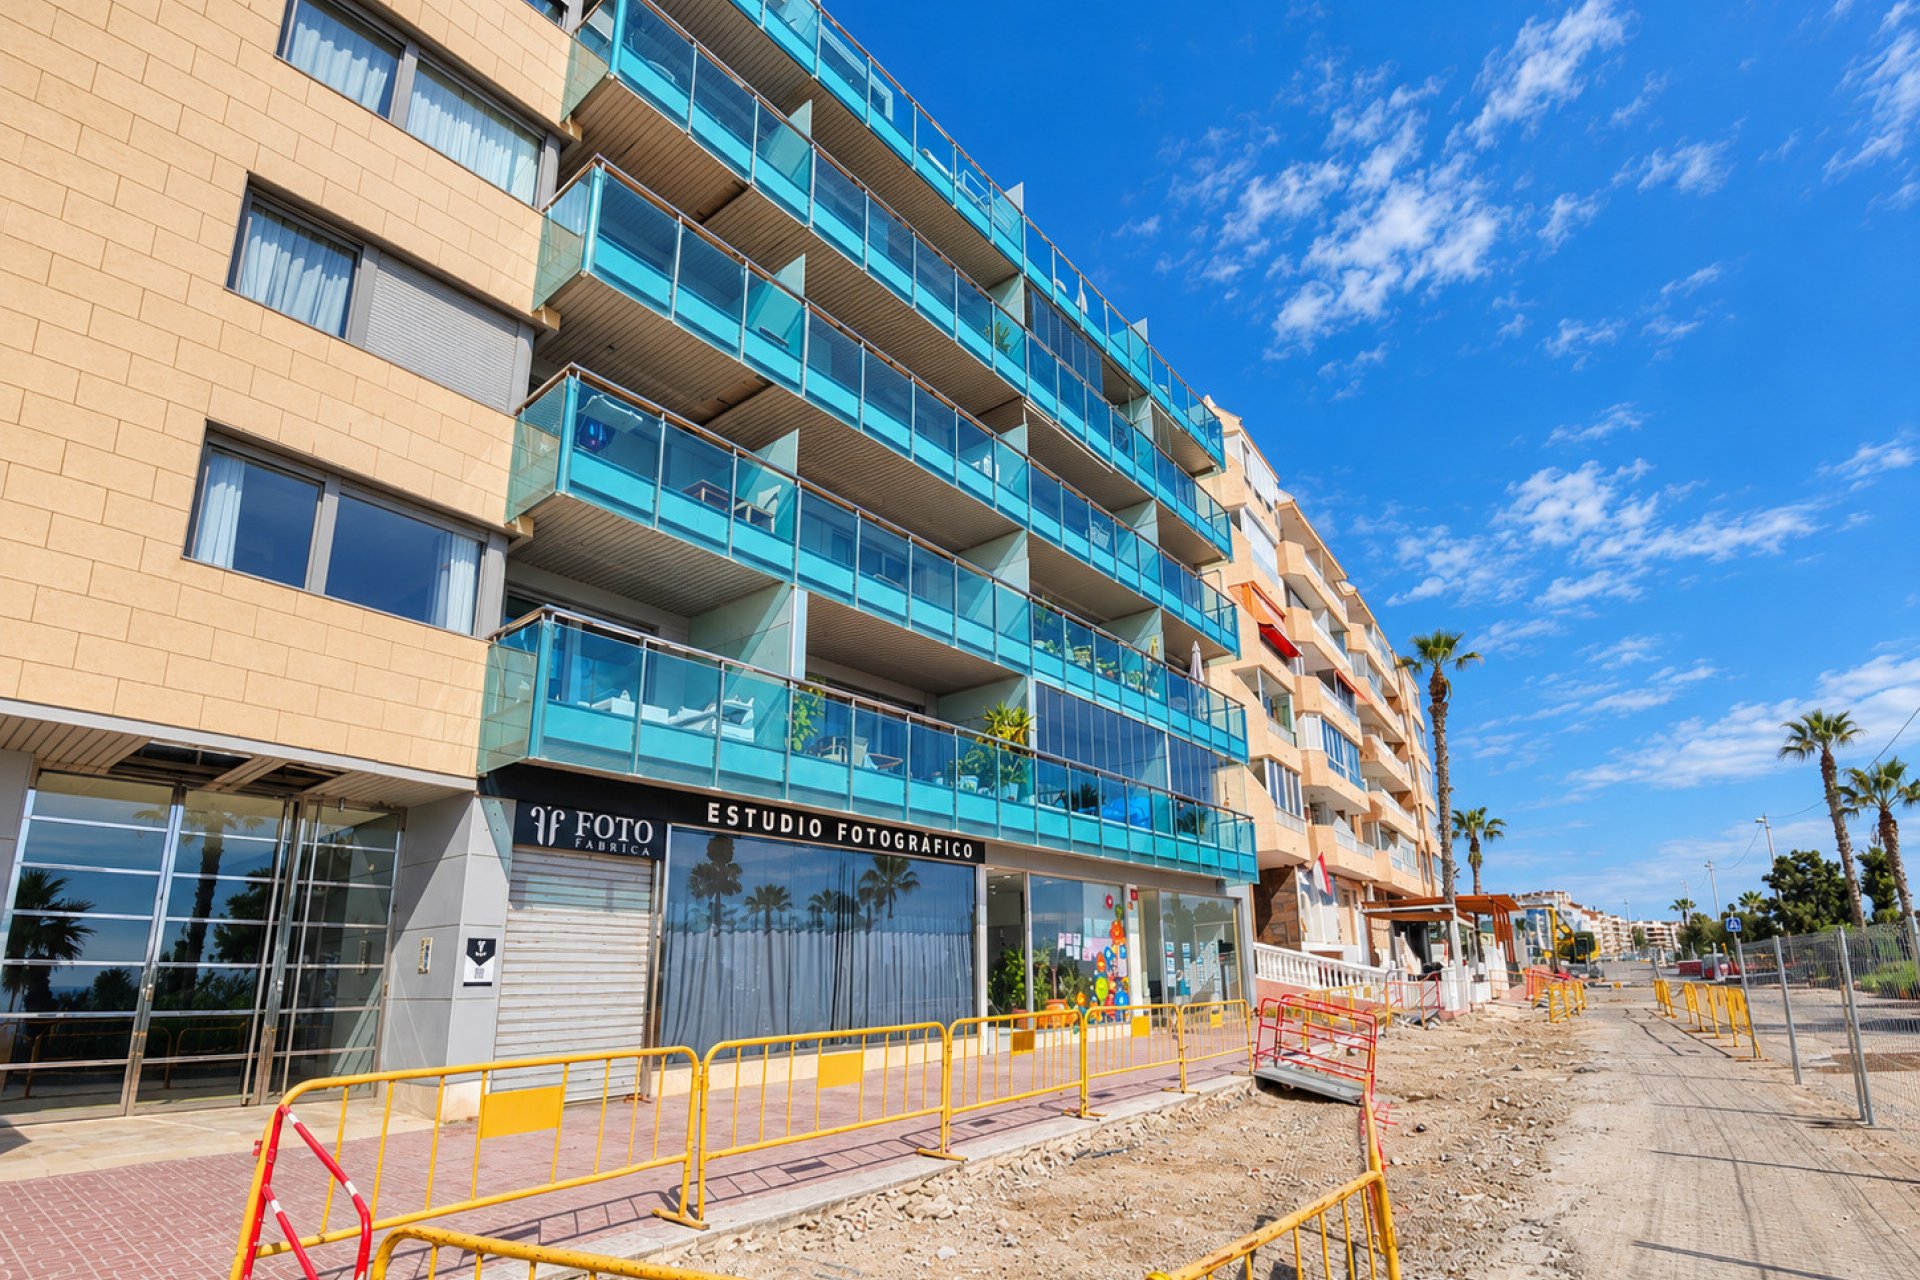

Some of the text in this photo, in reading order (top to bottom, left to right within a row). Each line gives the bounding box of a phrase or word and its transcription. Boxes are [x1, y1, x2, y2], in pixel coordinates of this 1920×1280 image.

[574, 810, 654, 844] FOTO
[707, 802, 973, 858] ESTUDIO FOTOGRÁFICO
[574, 838, 650, 856] FABRICA
